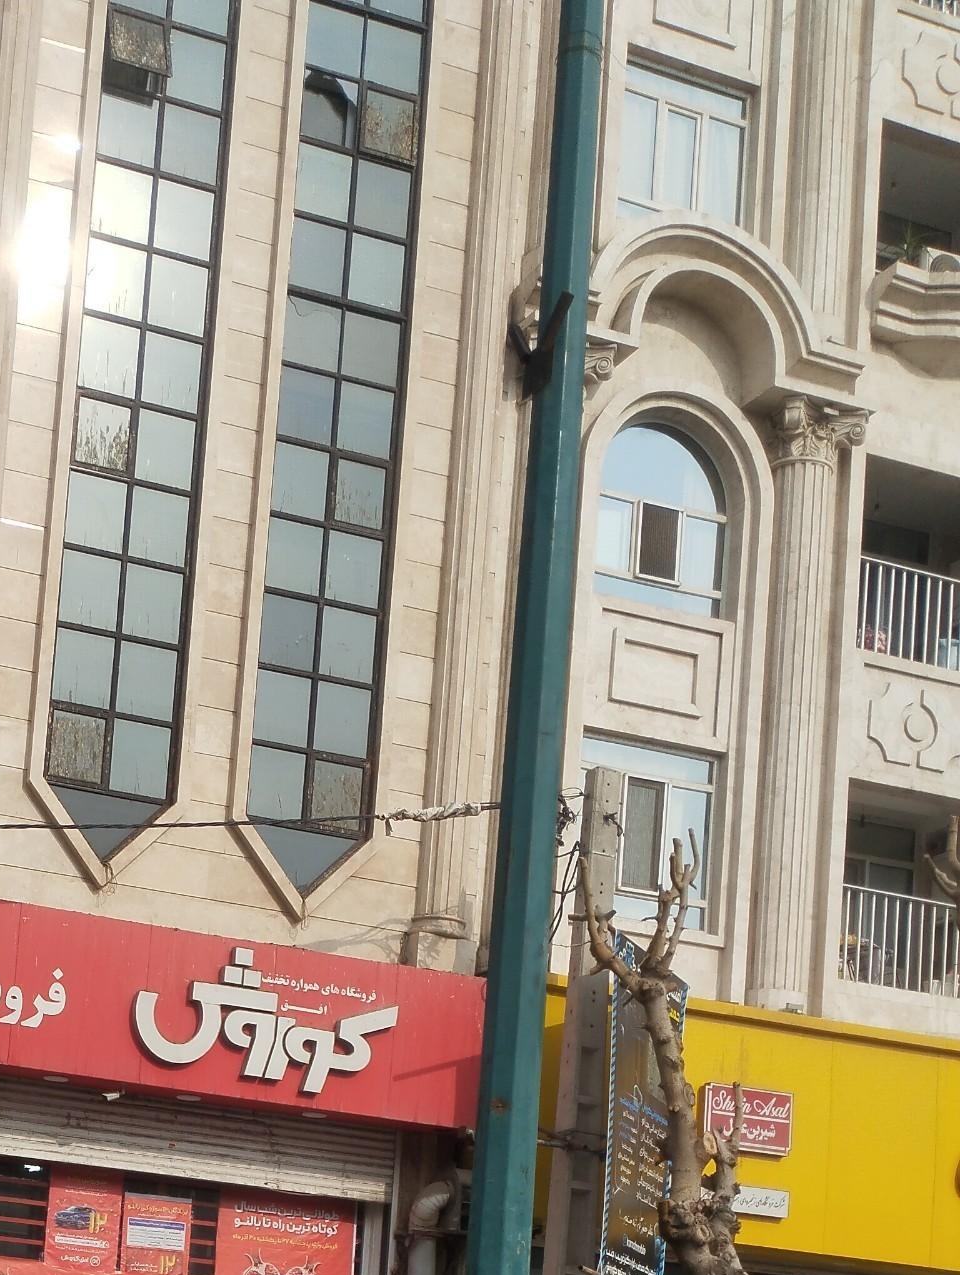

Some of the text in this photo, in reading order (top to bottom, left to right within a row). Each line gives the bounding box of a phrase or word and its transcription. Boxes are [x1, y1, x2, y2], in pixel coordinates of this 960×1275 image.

[261, 972, 377, 1003] فروشگاه های همواره تخفیف
[280, 1000, 328, 1015] افق
[135, 946, 400, 1095] کوروش
[712, 1090, 790, 1118] Shiin Asal
[723, 1117, 776, 1141] شیرین عل
[234, 1200, 340, 1223] طولانی ترین شب سال
[234, 1215, 339, 1238] کوتاه ترین راه تا بالنو
